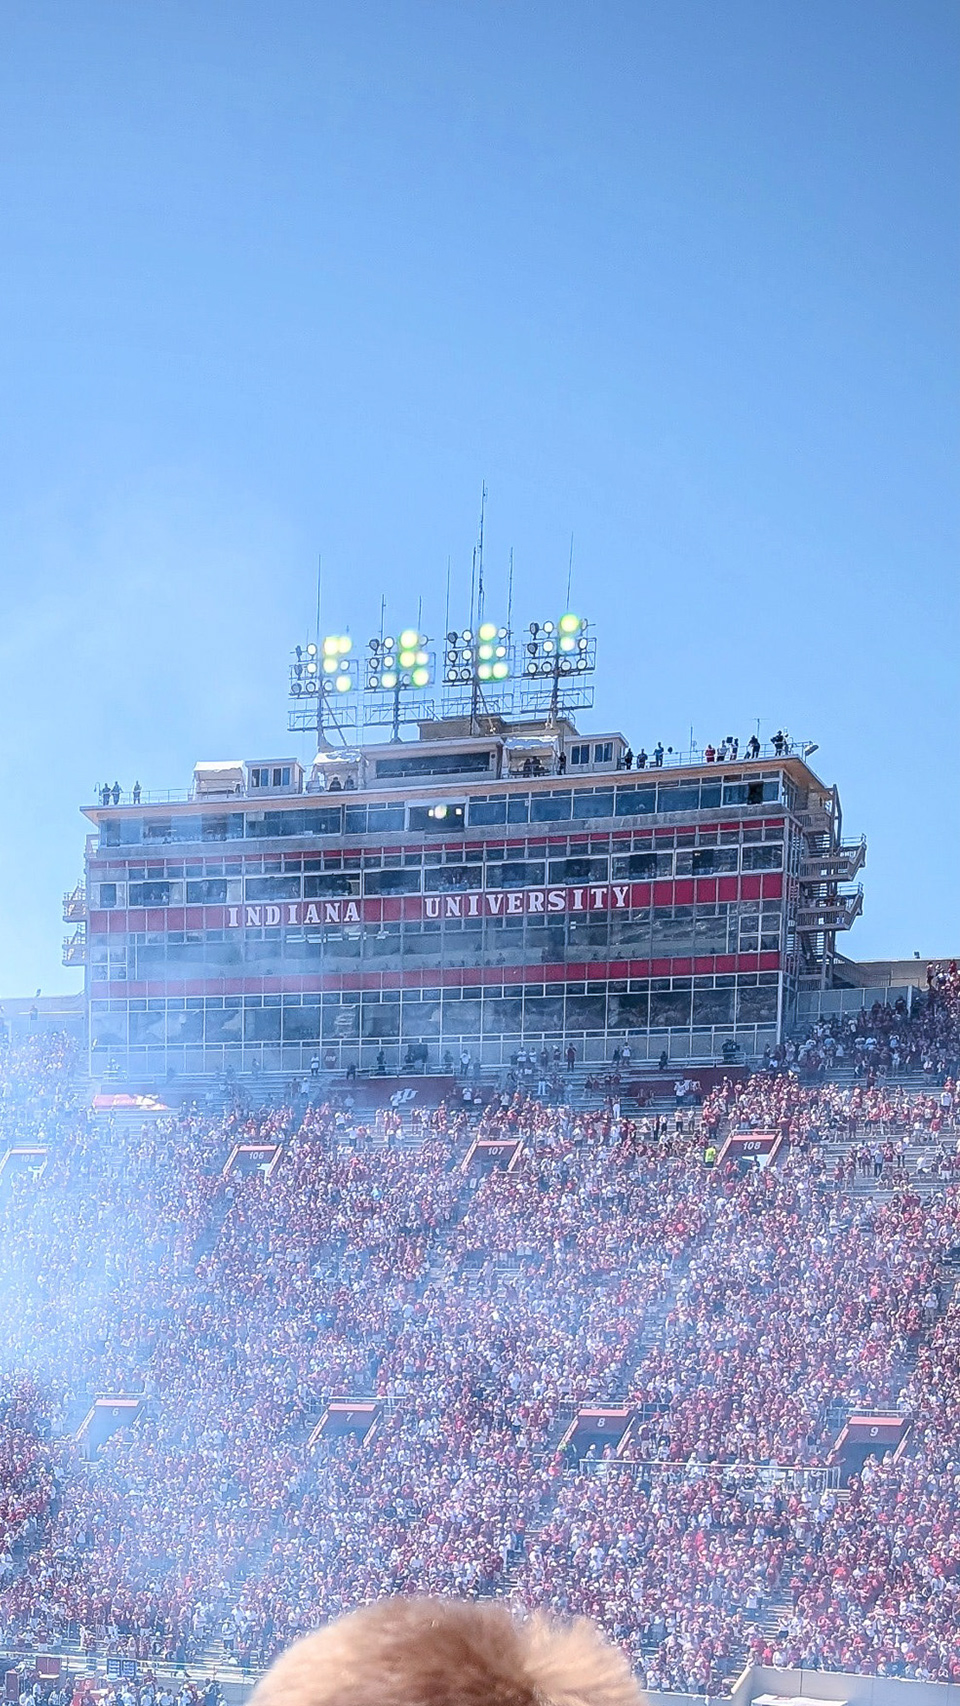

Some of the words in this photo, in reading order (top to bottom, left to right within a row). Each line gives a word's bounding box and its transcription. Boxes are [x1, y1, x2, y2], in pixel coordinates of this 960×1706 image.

[228, 901, 361, 928] INDIANA
[425, 885, 630, 918] UNIVERSITY
[487, 1146, 505, 1156] 107
[743, 1141, 762, 1151] 108
[249, 1151, 265, 1160] 106
[111, 1407, 120, 1417] 6
[346, 1412, 354, 1422] 7
[597, 1417, 606, 1427] 8
[869, 1426, 879, 1437] 9
